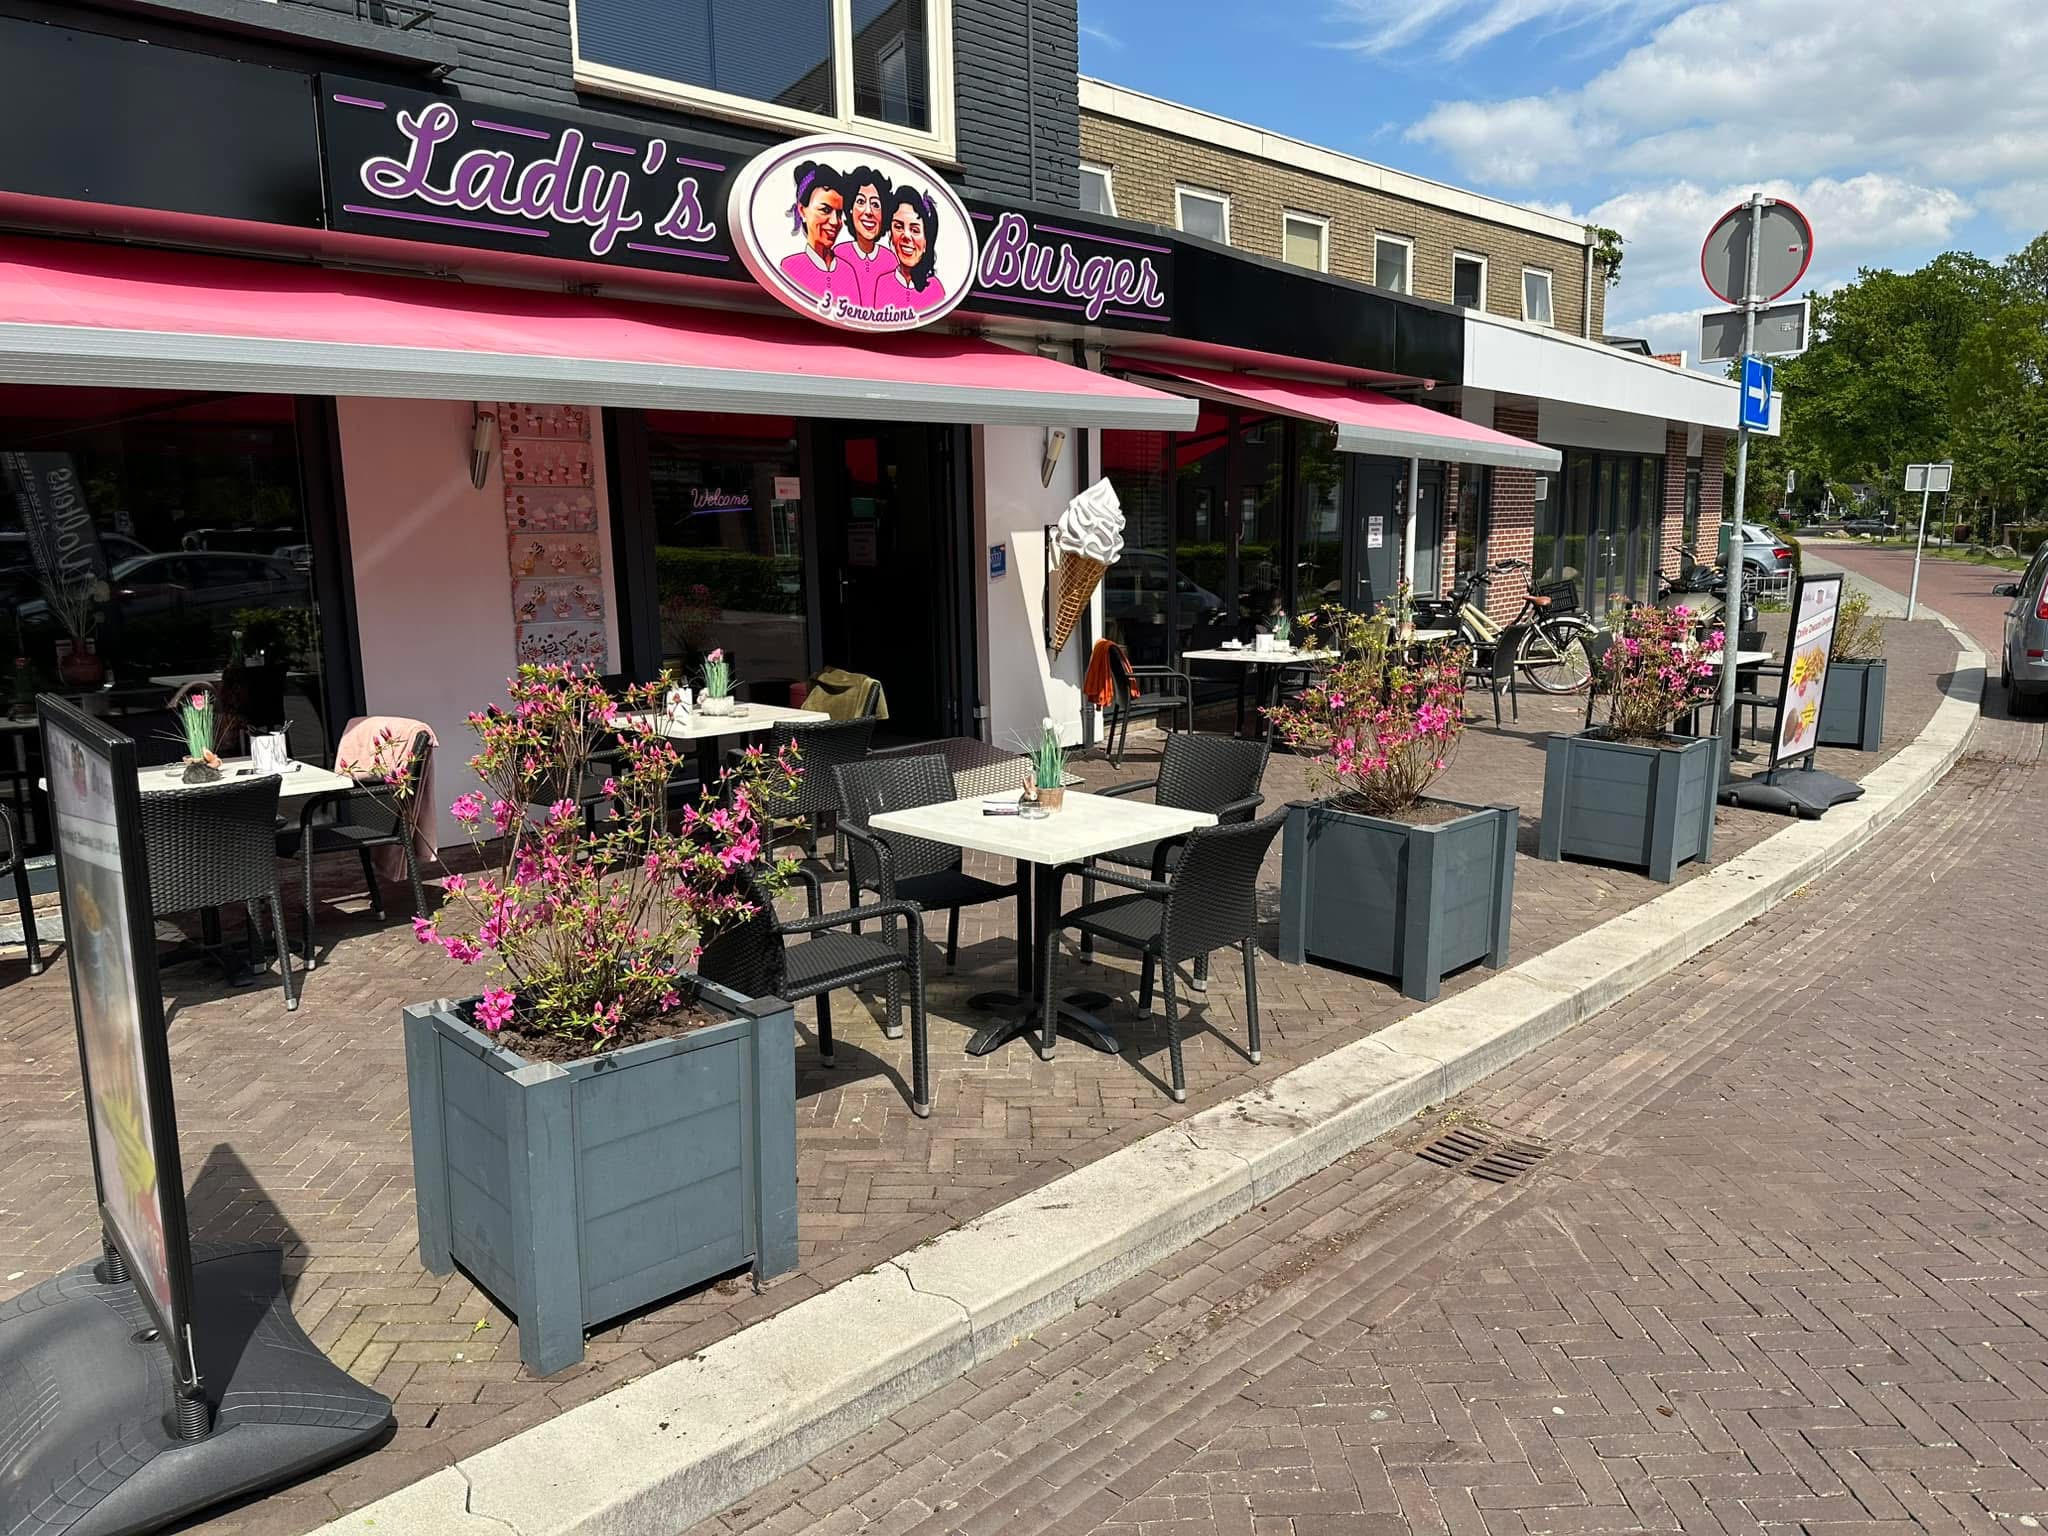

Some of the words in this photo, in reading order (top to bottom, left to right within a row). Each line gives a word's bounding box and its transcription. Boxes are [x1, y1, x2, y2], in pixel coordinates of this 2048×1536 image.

[360, 102, 716, 255] Lady's
[978, 212, 1165, 321] Burger
[821, 292, 832, 309] 3
[836, 298, 916, 322] Generations
[691, 487, 750, 507] Welcome
